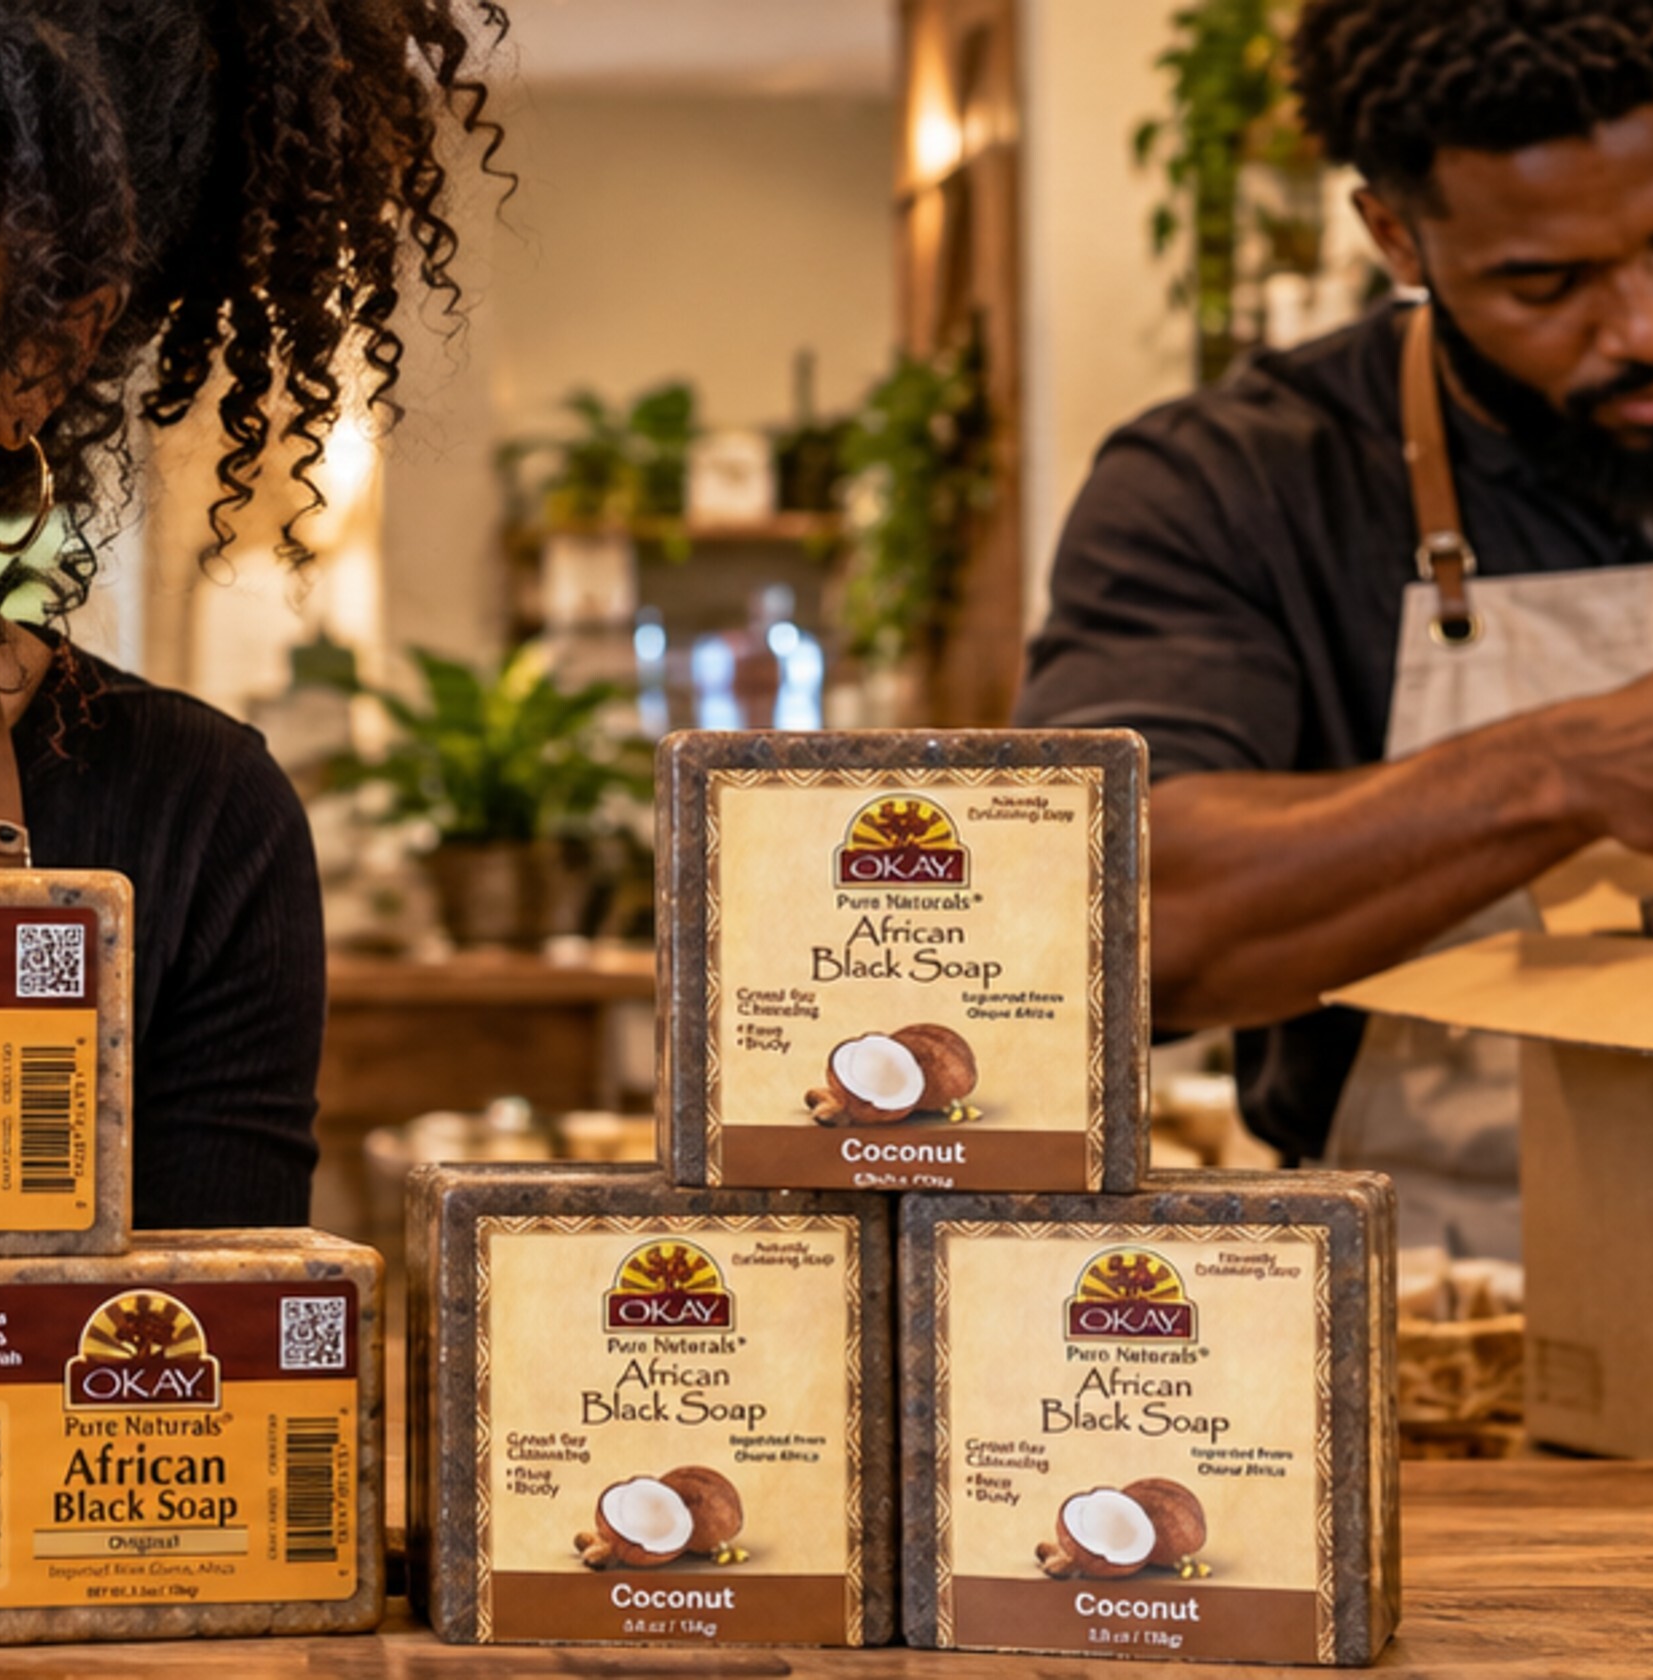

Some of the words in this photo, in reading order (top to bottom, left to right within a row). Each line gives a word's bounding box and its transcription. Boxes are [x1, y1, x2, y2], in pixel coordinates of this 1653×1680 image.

[846, 915, 966, 946] African
[811, 947, 902, 981] Black
[908, 949, 1003, 988] Soap
[840, 1137, 967, 1163] Coconut
[616, 1358, 730, 1390] African
[1076, 1367, 1193, 1399] African
[64, 1415, 119, 1437] Pure
[581, 1391, 670, 1424] Black
[676, 1391, 766, 1430] Soap
[1041, 1399, 1131, 1433] Black
[1138, 1402, 1230, 1442] Soap
[64, 1444, 227, 1487] African
[53, 1491, 145, 1523] Black
[157, 1490, 239, 1528] Soap
[611, 1582, 735, 1609] Coconut
[1075, 1591, 1200, 1621] Coconut
